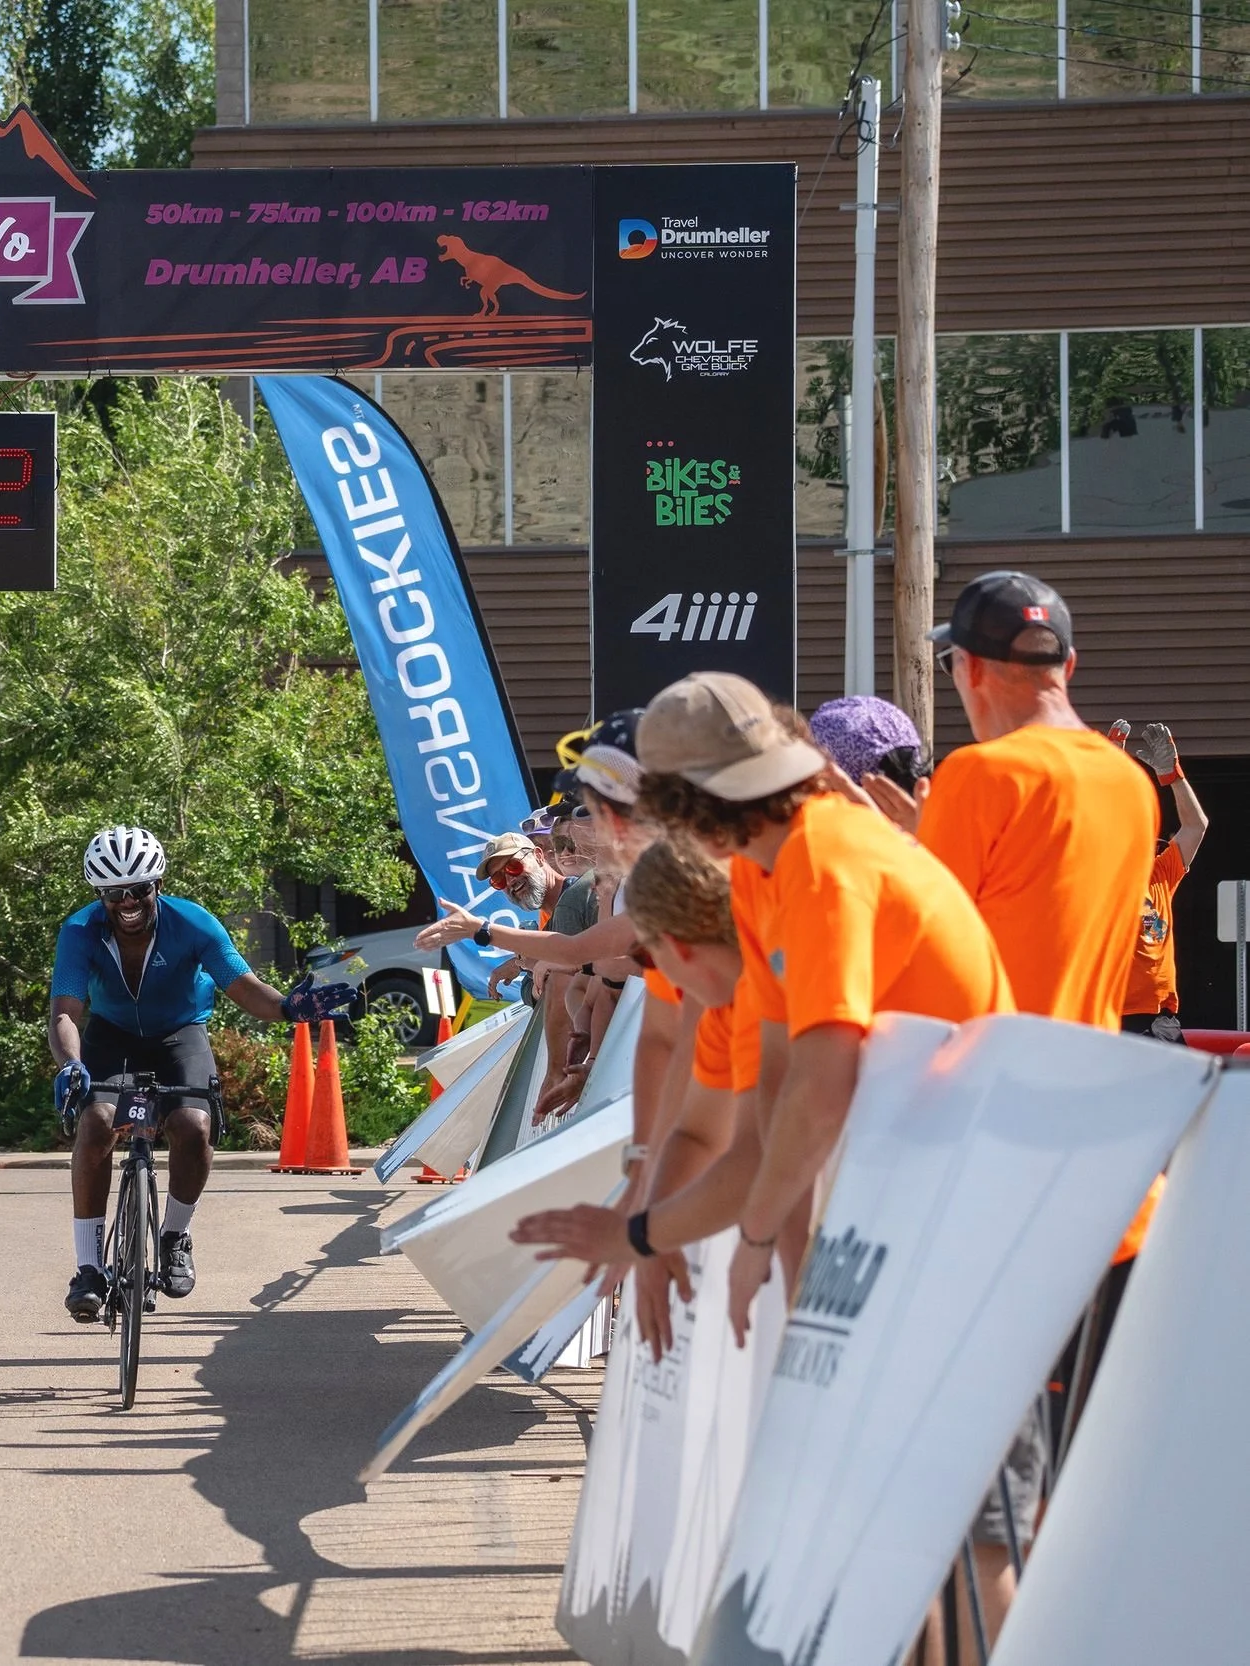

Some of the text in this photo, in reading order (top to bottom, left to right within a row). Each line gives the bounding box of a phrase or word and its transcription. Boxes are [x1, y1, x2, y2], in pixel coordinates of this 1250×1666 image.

[145, 203, 223, 224] 50km
[247, 202, 321, 223] 75km
[347, 201, 436, 223] 100km
[461, 199, 550, 222] 162km
[662, 215, 698, 228] Travel
[661, 227, 770, 245] Drumheller
[661, 250, 768, 259] UNCOVER WONDER
[145, 256, 428, 289] Drumheller, AB
[672, 340, 758, 354] WOLFE
[675, 355, 755, 363] CHEVROLET
[681, 363, 748, 371] GMC BUICK
[630, 592, 758, 641] 4iiii
[128, 1106, 146, 1120] 68
